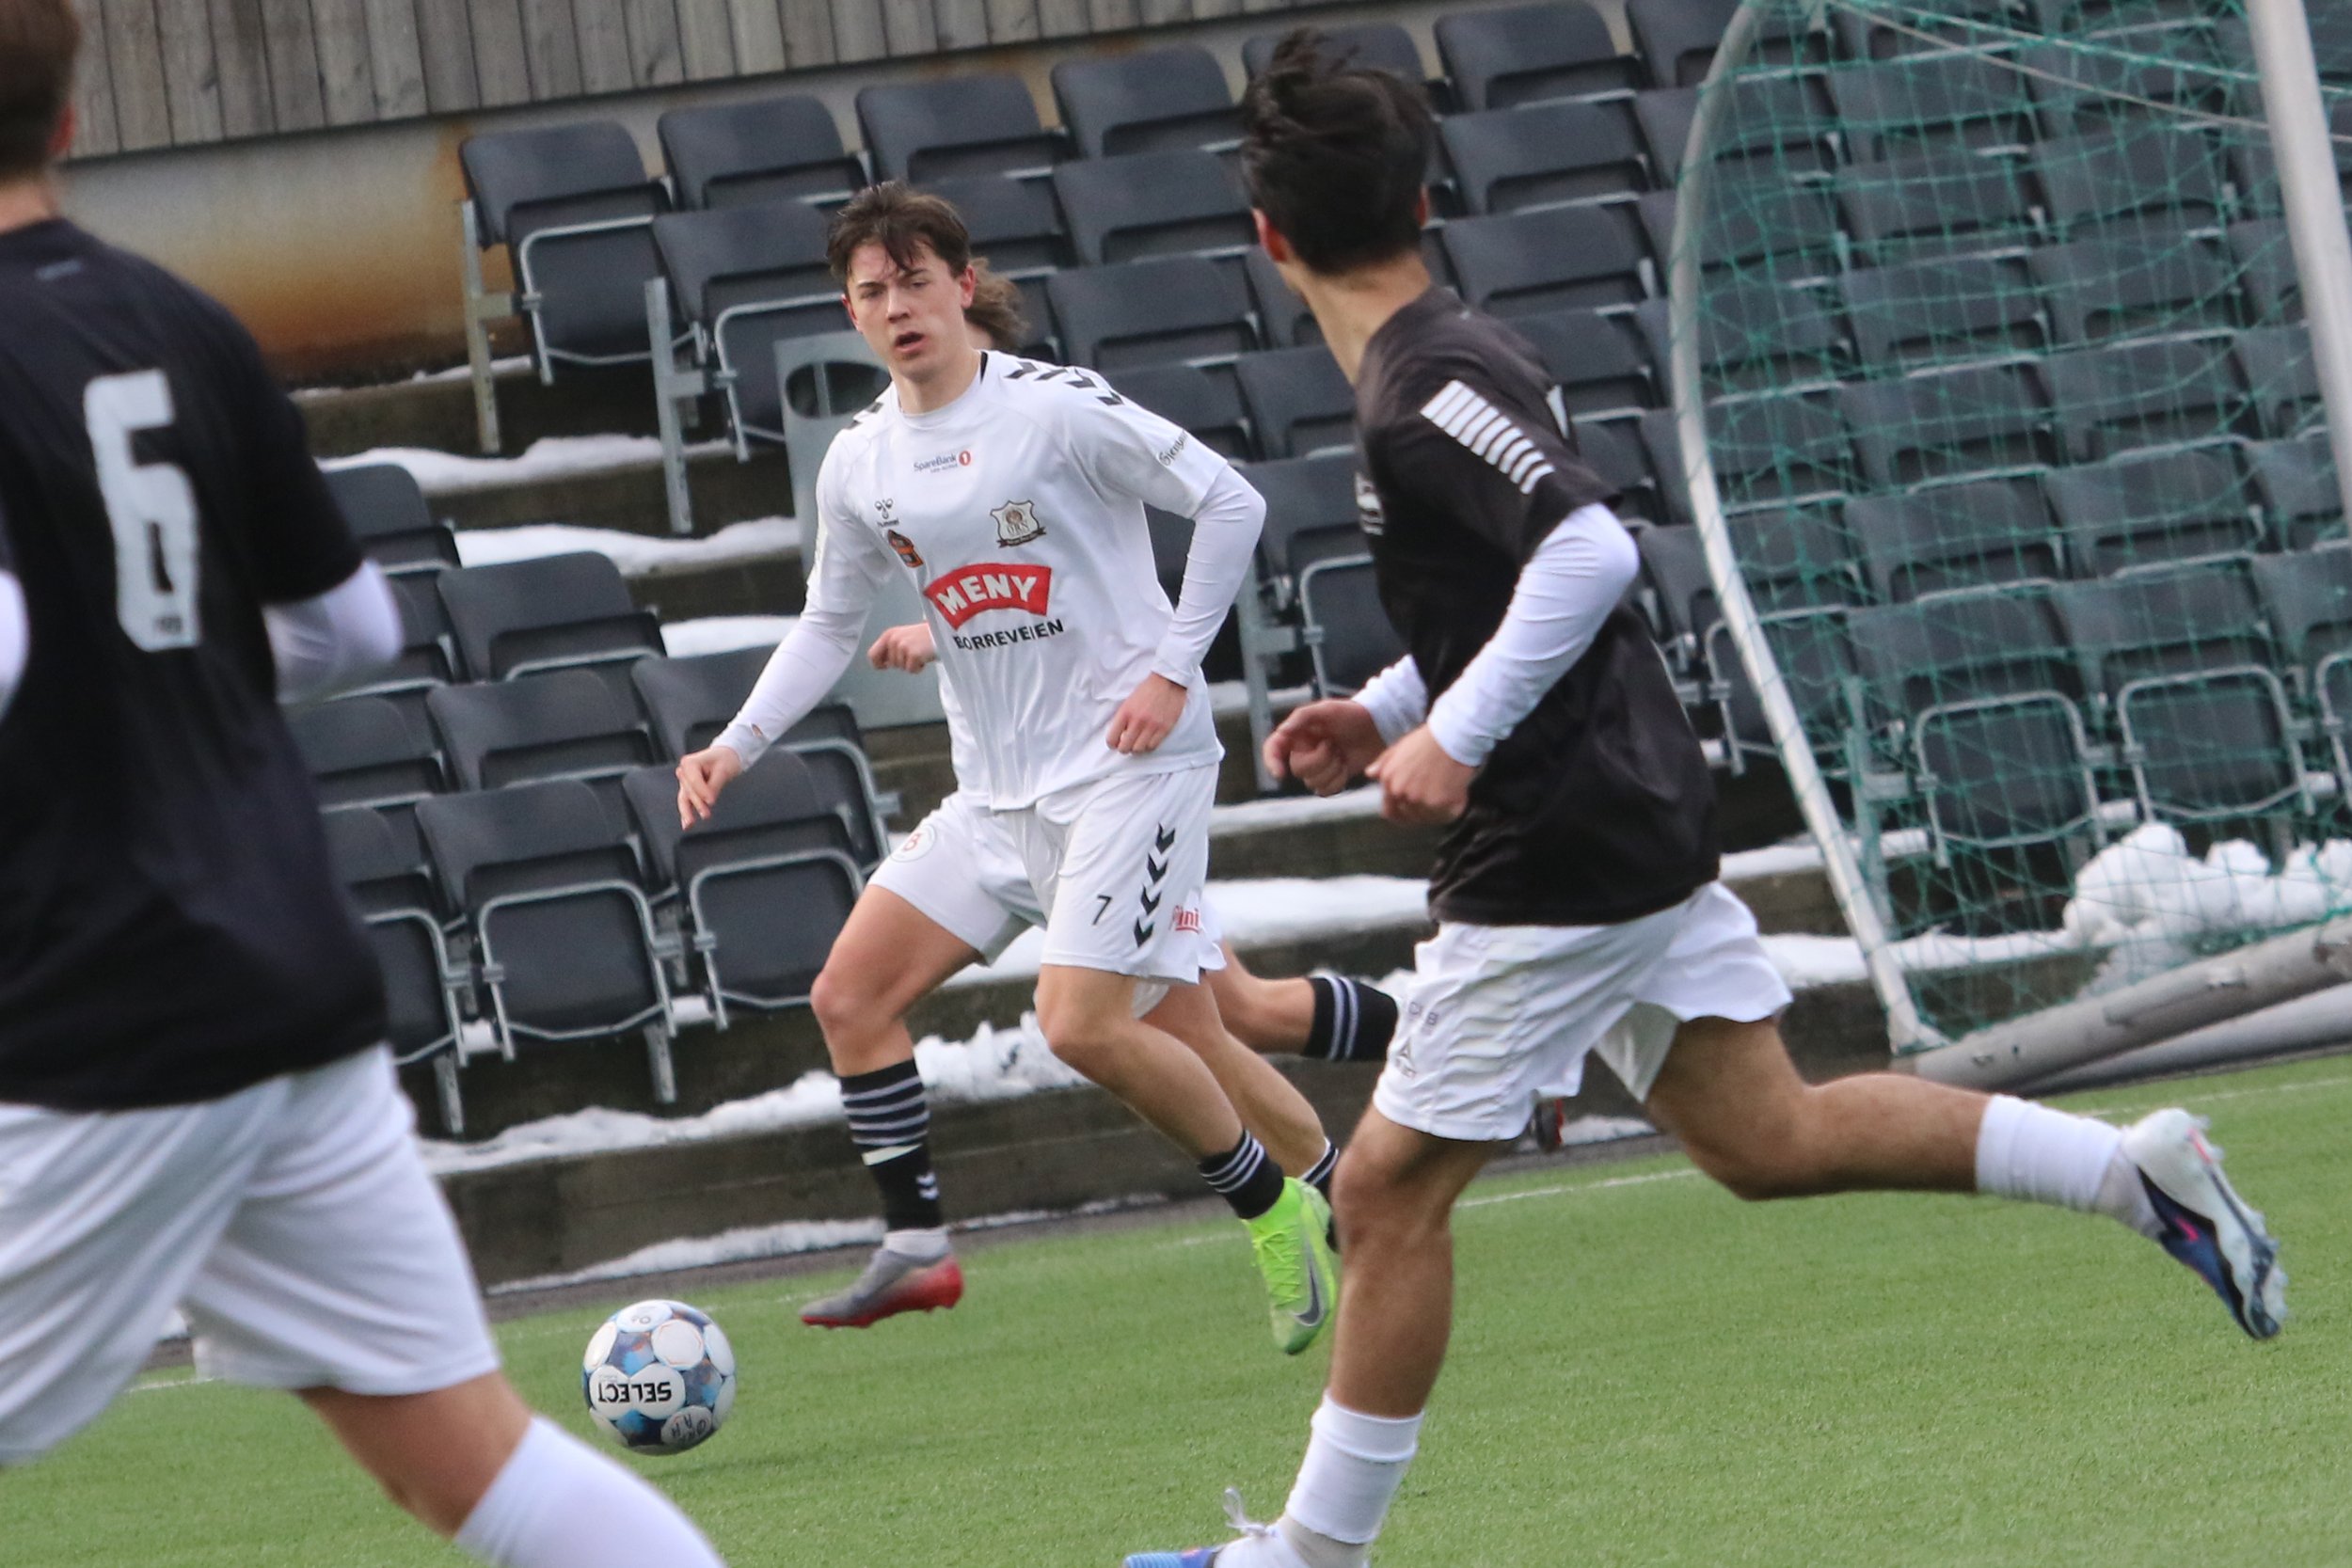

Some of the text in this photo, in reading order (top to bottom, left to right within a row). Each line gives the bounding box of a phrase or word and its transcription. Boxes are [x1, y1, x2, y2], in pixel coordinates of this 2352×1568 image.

[83, 369, 200, 653] 6
[936, 573, 1037, 616] MENY
[953, 619, 1064, 650] BORREVEIEN
[1091, 895, 1112, 926] 7
[598, 1382, 672, 1402] SELECT
